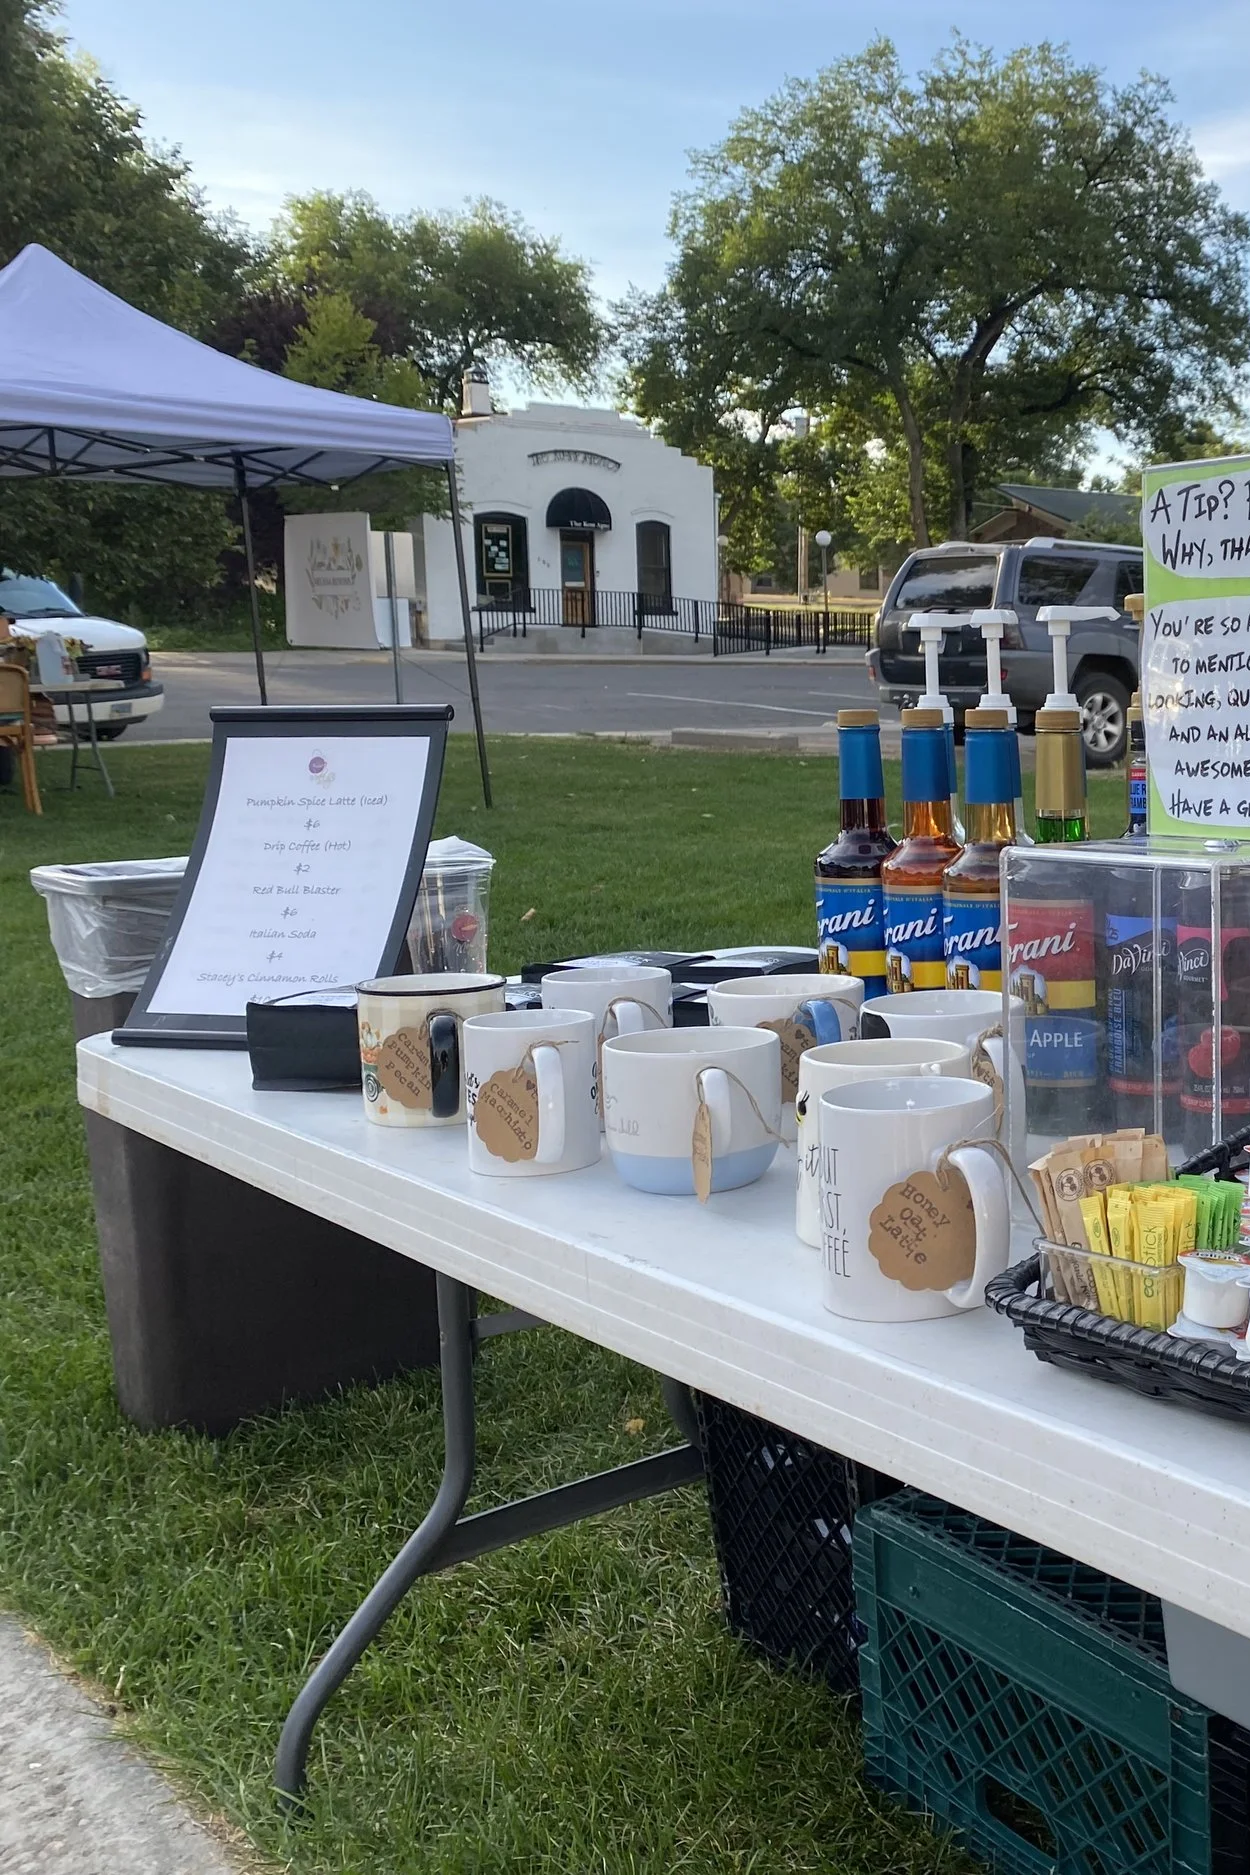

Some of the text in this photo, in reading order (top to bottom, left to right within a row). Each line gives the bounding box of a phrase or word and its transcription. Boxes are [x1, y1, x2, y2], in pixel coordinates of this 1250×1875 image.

[1151, 489, 1171, 524] A
[1162, 529, 1213, 570] WHY,
[1221, 617, 1241, 636] SO
[1172, 657, 1190, 675] TO
[1169, 725, 1200, 744] AND
[1207, 724, 1229, 743] AN
[246, 795, 388, 807] Pumpkin Spice Latte (Iced)
[1169, 789, 1213, 819] HAVE
[1219, 799, 1231, 815] A
[304, 819, 321, 830] $6
[263, 840, 352, 853] Drip Coffee (Hot)
[293, 864, 310, 875] $2
[252, 886, 341, 895] Red Bull Blaster
[280, 907, 298, 919] $6
[249, 929, 316, 939] Italian Soda
[267, 951, 284, 963] $4
[196, 973, 339, 987] Stacey's Cinnamon Rolls
[386, 1061, 420, 1097] Pecan
[490, 1083, 533, 1127] Caramel
[900, 1183, 950, 1228] Honey
[900, 1207, 926, 1242] Oat
[880, 1215, 927, 1265] Latte
